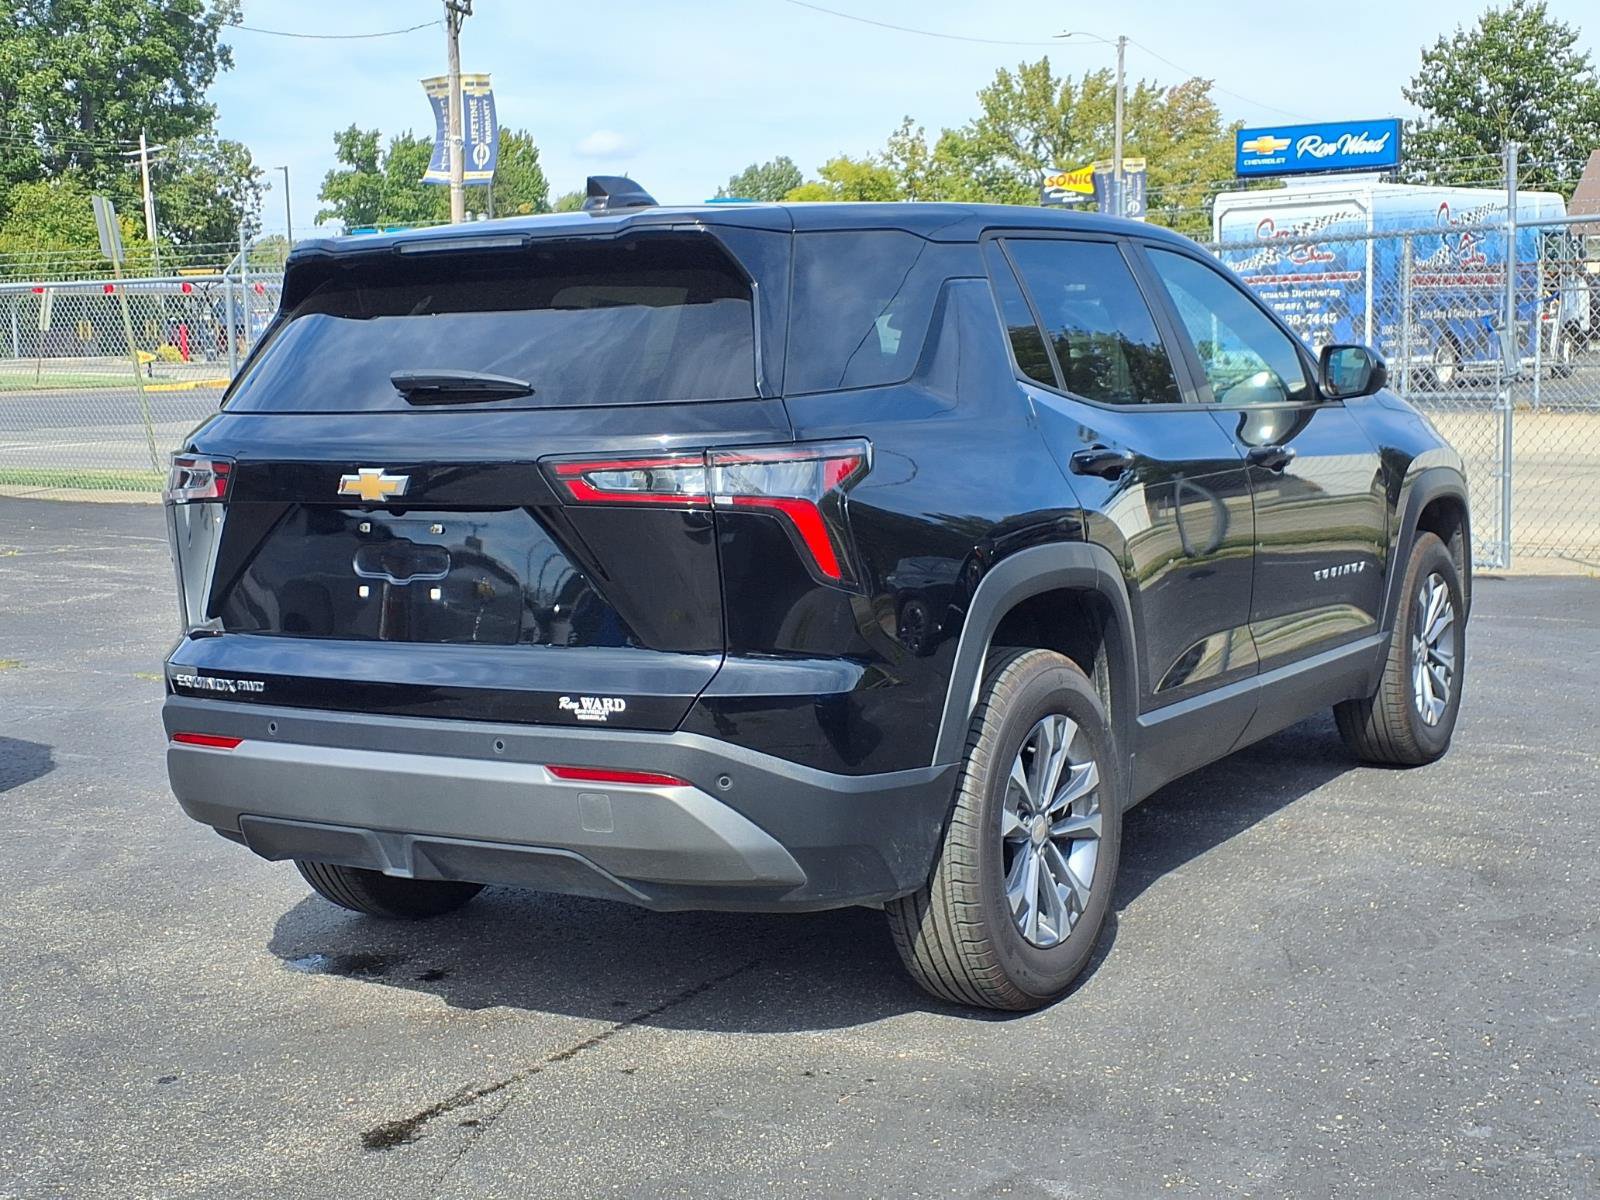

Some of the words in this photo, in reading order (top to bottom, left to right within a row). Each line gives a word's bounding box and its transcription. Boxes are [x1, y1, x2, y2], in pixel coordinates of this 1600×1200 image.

[1244, 157, 1286, 166] CHEVROLET
[1047, 172, 1092, 188] SONIC
[176, 674, 236, 693] EQUINOX
[580, 696, 626, 712] WARD
